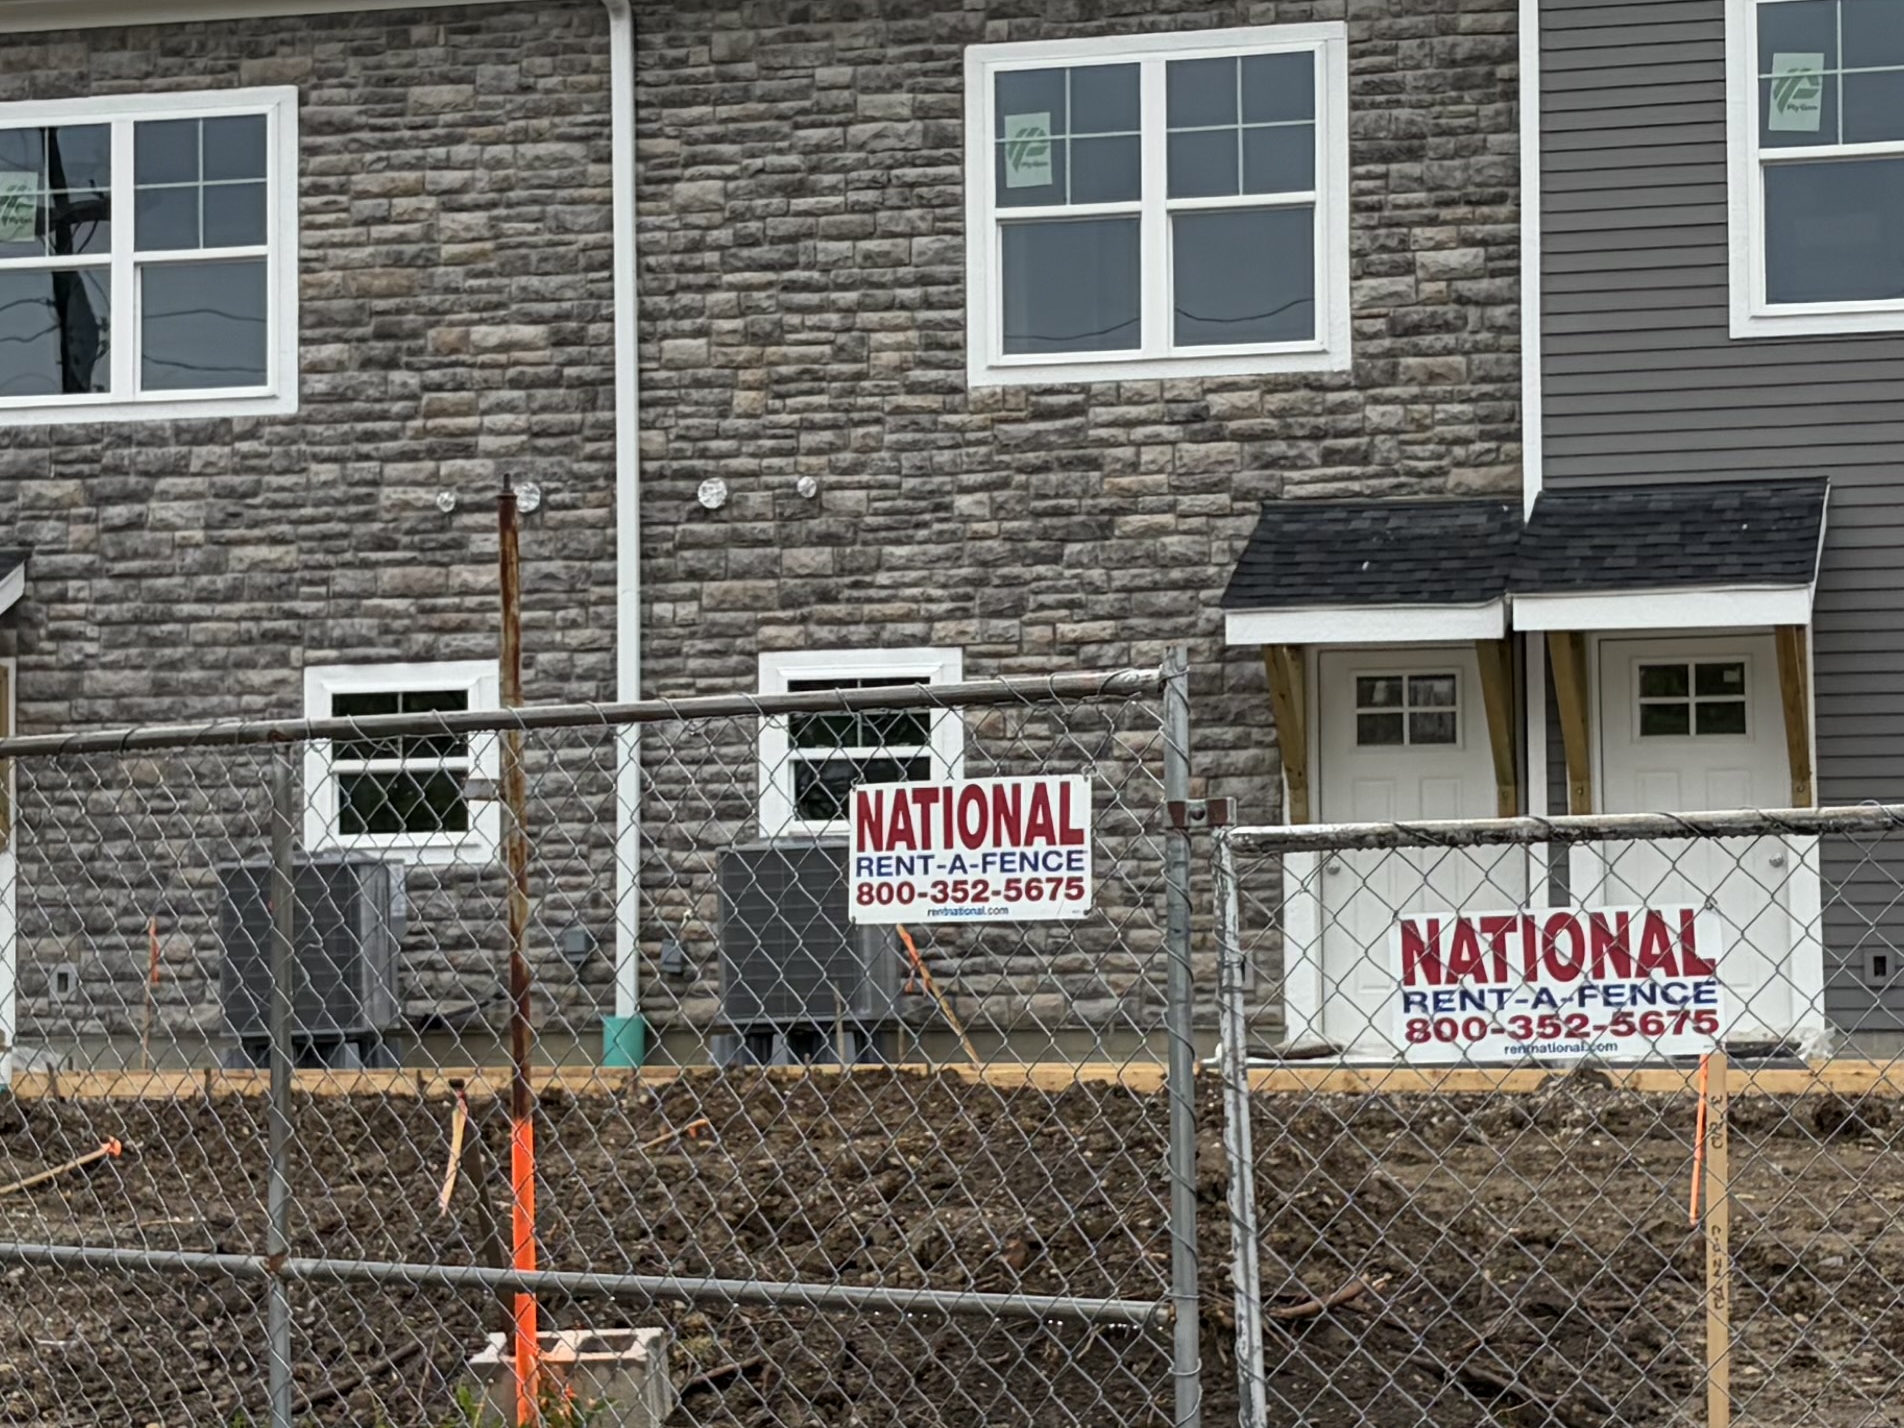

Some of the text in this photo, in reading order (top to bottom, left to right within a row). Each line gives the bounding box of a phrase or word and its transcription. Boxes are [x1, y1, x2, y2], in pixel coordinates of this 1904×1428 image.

[856, 781, 1085, 853] NATIONAL
[856, 849, 1085, 877] RENT-A-FENCE
[856, 876, 1085, 905] 800-352-5675
[927, 905, 1009, 917] rentnational.com
[1401, 908, 1716, 987] NATIONAL
[1403, 980, 1718, 1013] RENT-A-FENCE
[1405, 1009, 1719, 1044] 800-352-5675
